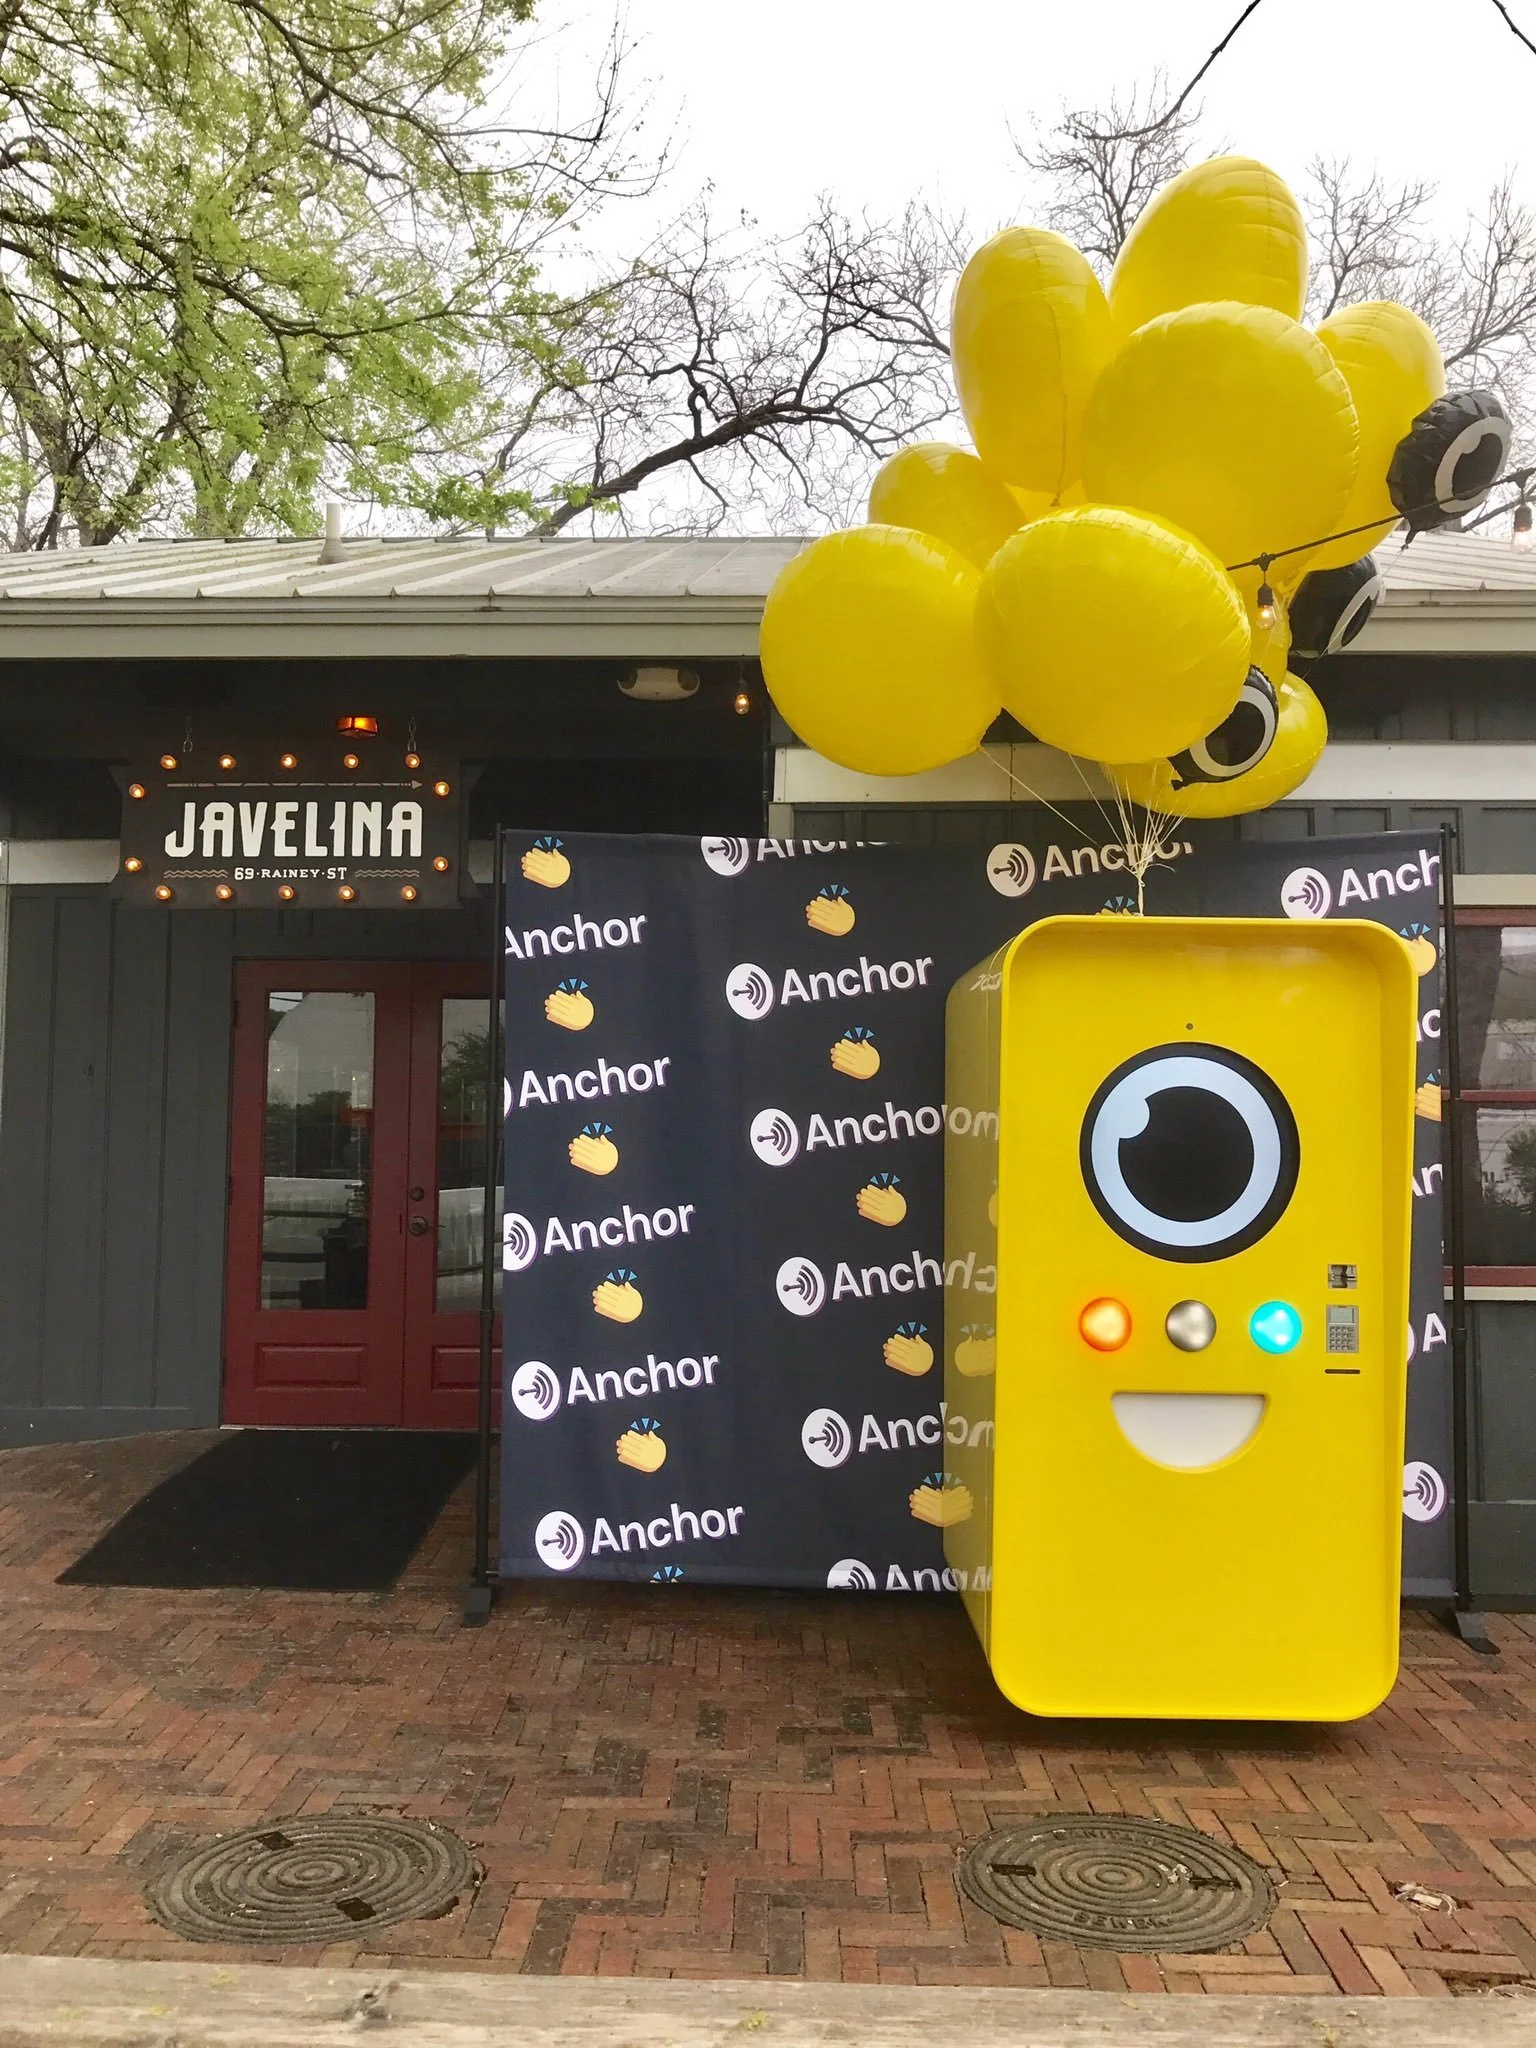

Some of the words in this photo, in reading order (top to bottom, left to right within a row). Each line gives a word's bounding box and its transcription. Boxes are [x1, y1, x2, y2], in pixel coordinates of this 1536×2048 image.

[165, 801, 422, 857] JAVELINA
[505, 913, 648, 959] Anchor
[781, 956, 933, 1005] Anchor
[518, 1056, 671, 1108] Anchor
[543, 1204, 694, 1255] Anchor
[832, 1250, 945, 1300] Anch
[567, 1354, 719, 1405] Anchor
[858, 1402, 945, 1452] Anc
[591, 1502, 744, 1554] Anchor
